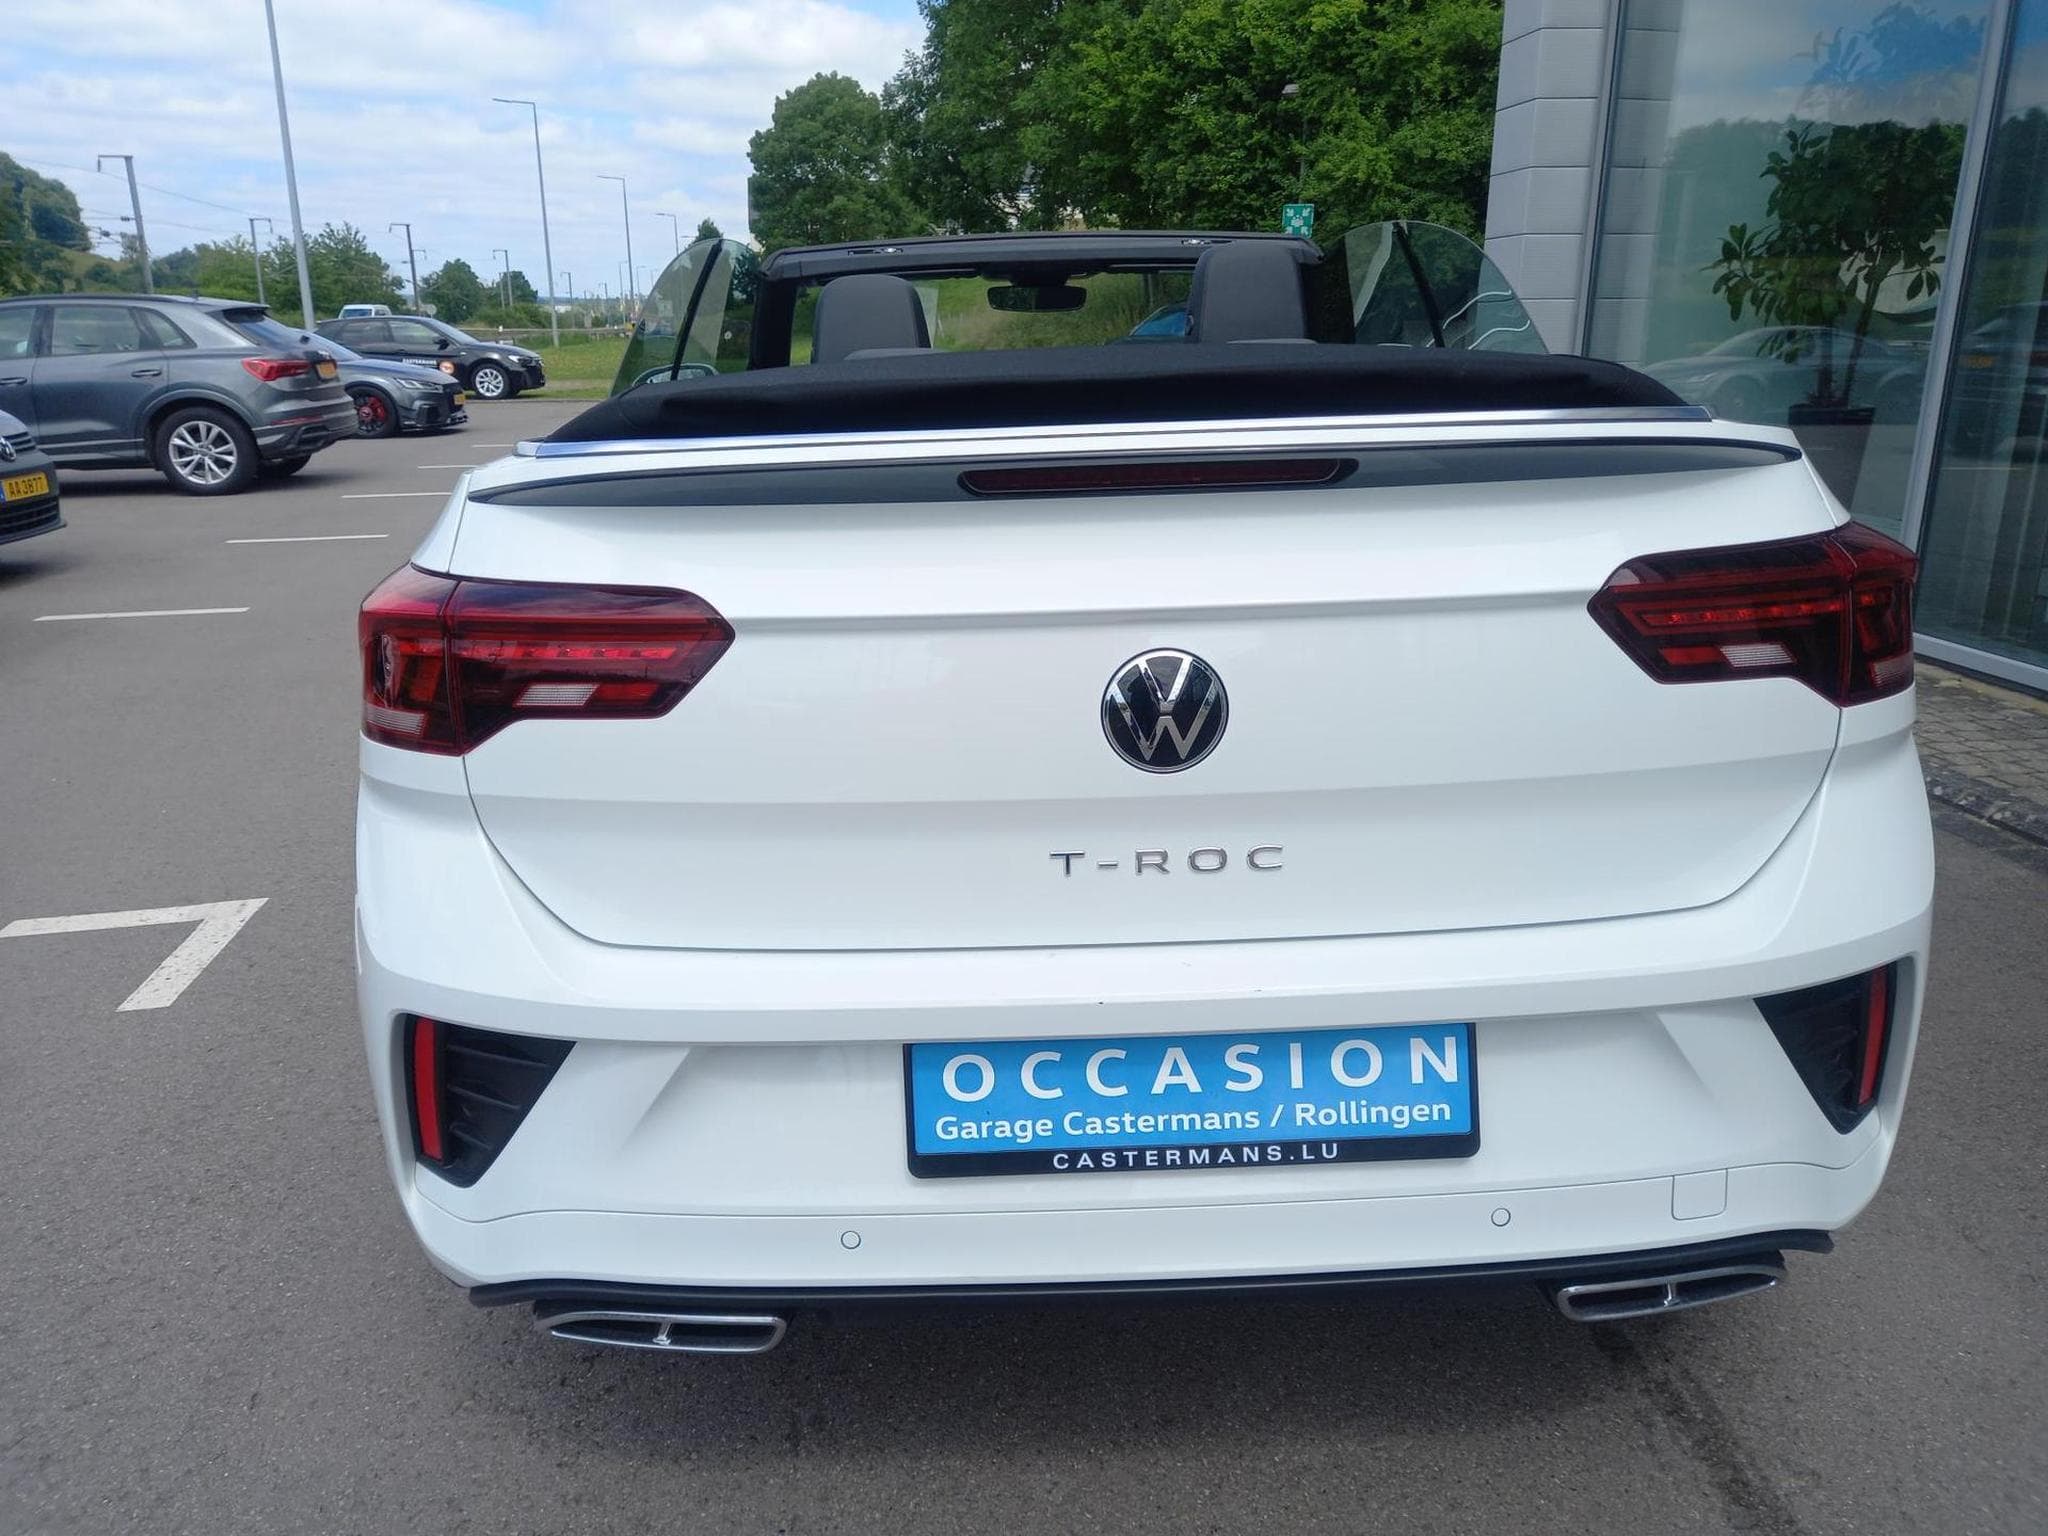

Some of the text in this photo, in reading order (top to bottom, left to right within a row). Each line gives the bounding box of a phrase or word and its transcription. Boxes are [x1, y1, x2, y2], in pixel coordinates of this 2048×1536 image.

[1050, 844, 1284, 877] T-ROC
[942, 1036, 1458, 1102] OCCASION
[935, 1100, 1451, 1144] Garage Castermans / Rollingen
[1053, 1143, 1338, 1170] CASTERMANS.LU
